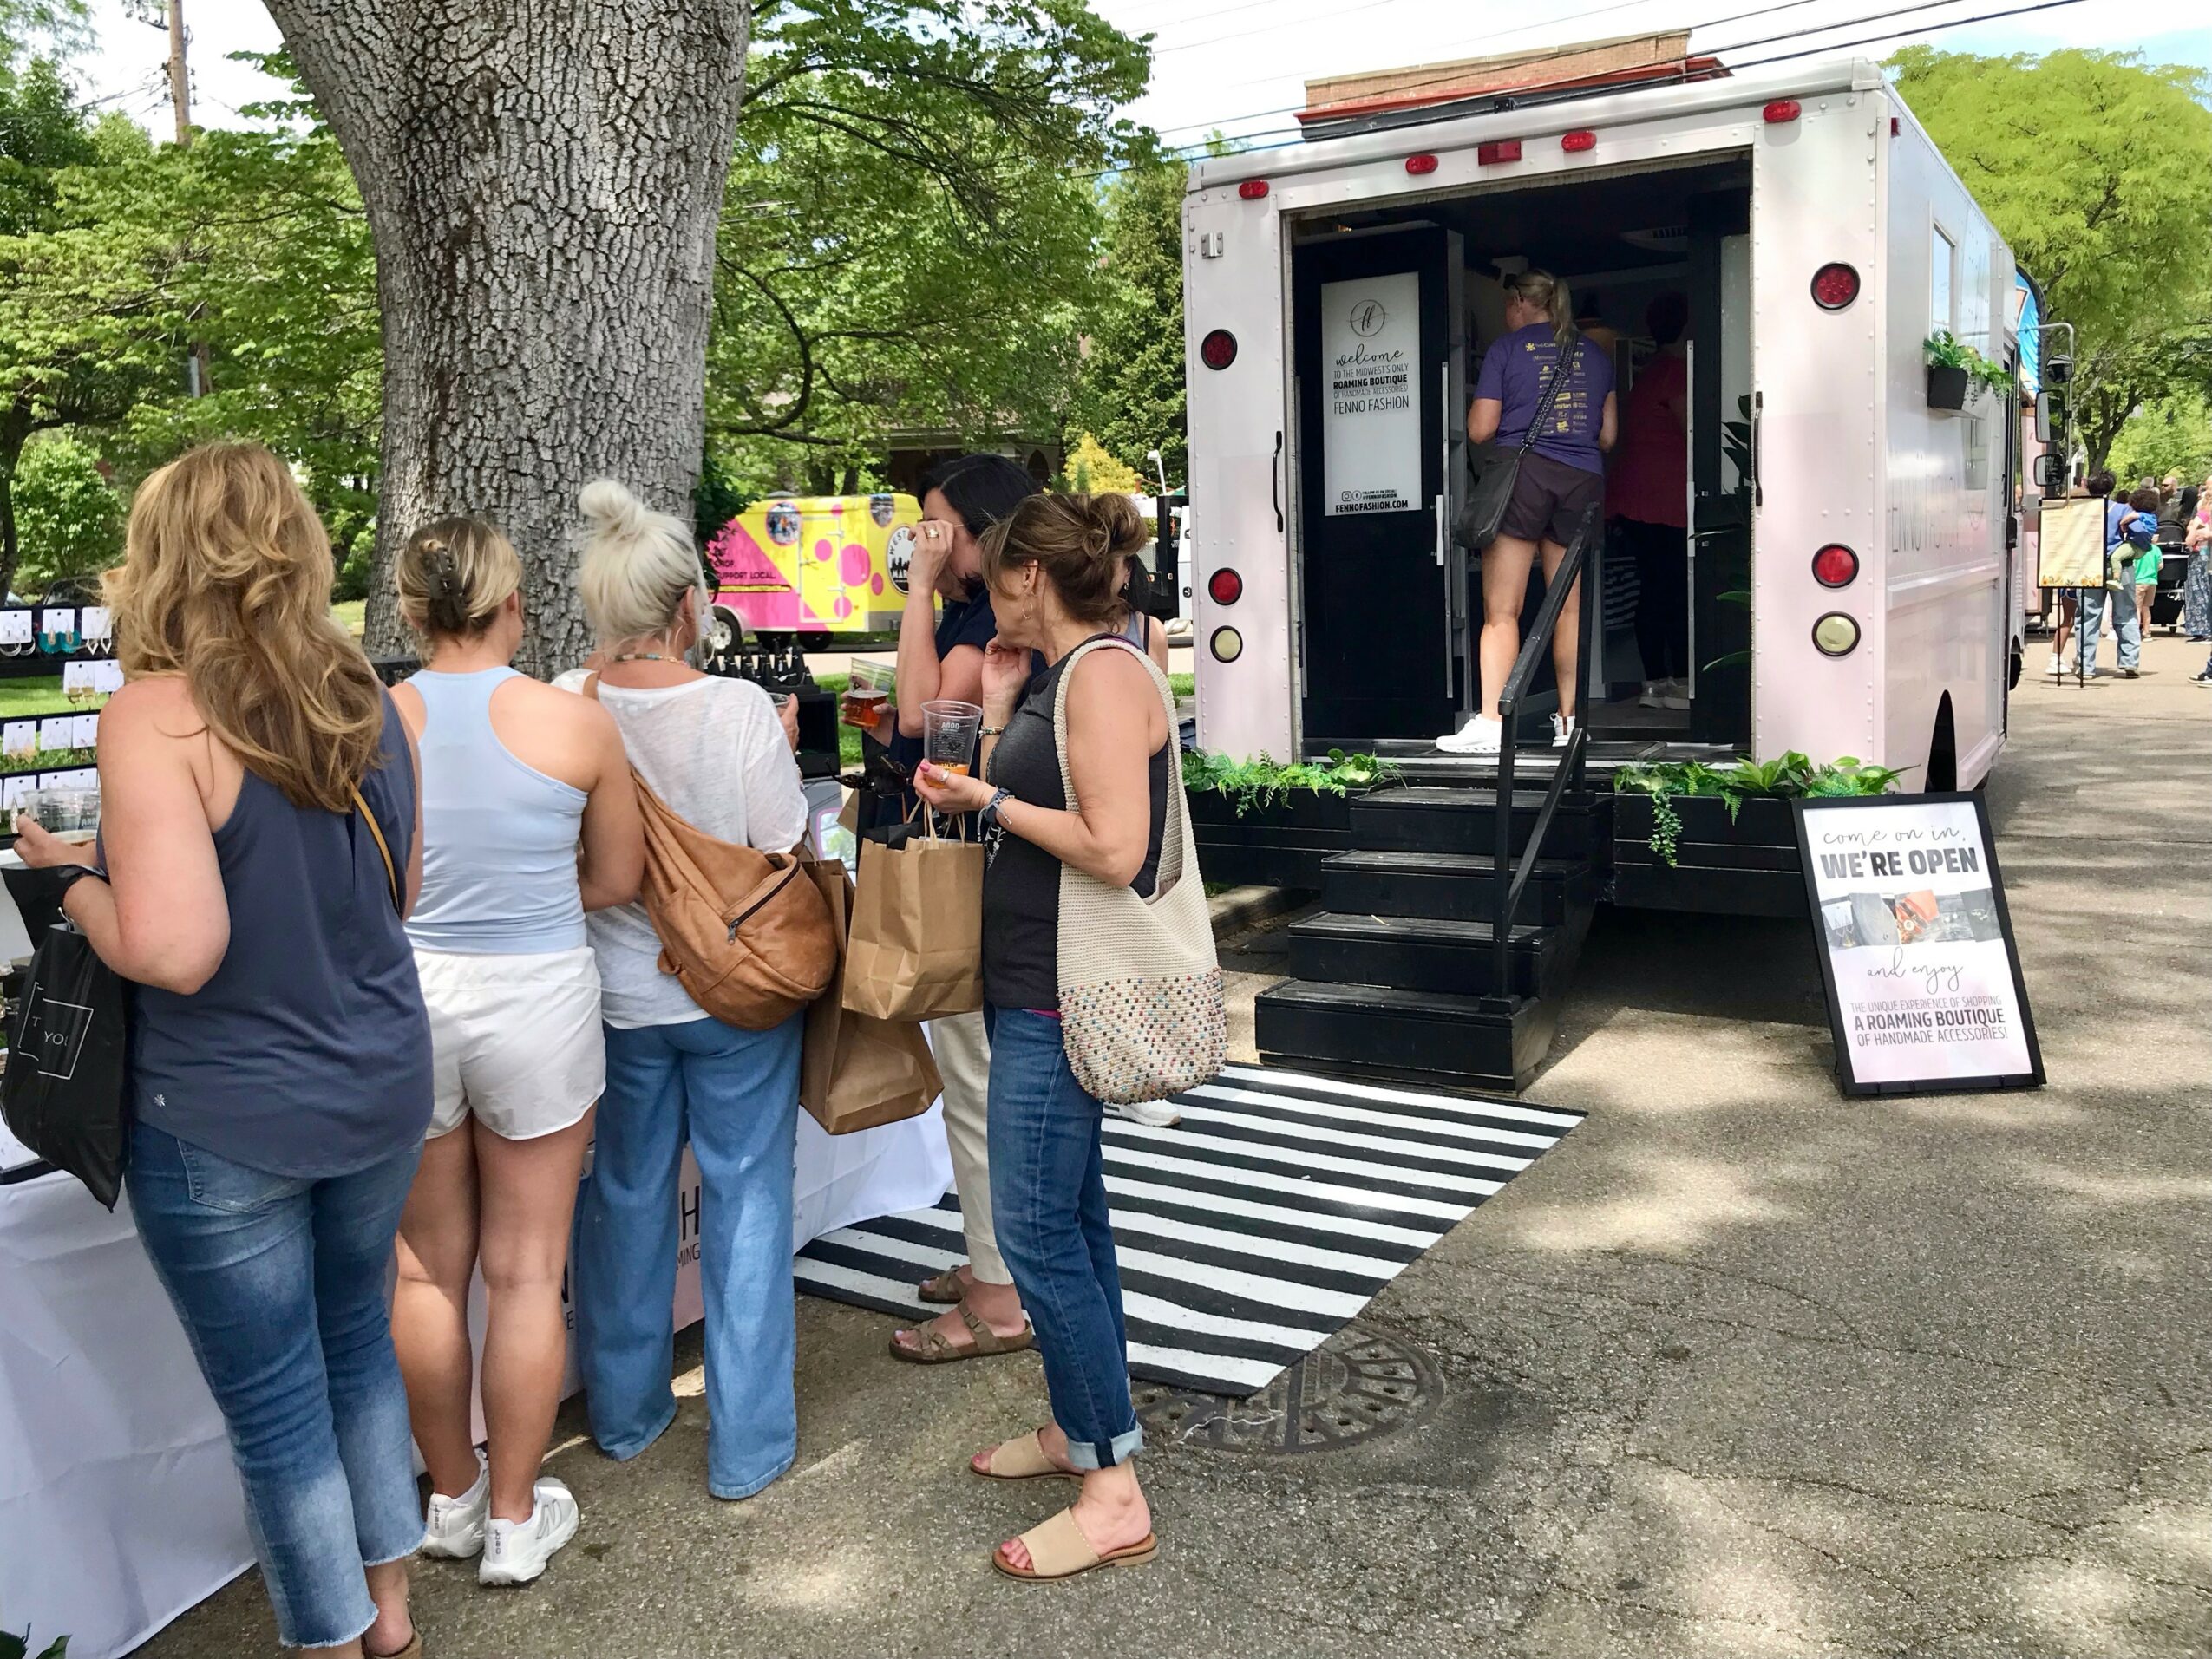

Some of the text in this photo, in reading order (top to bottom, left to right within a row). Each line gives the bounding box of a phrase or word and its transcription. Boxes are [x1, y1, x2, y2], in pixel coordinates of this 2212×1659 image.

[1336, 343, 1404, 366] welcome
[1334, 363, 1409, 379] TO THE MIDWEST'S ONLY
[1333, 374, 1408, 389] ROAMING BOUTIQUE
[1334, 395, 1410, 415] FENNO FASHION
[1335, 500, 1409, 513] FENNOFASHION.COM
[1823, 825, 1967, 846] come on in,
[1820, 847, 1980, 879] WE'RE OPEN
[1867, 946, 1964, 995] and enjoy
[1850, 995, 2002, 1014] THE UNIQUE EXPERIENCE OF SHOPPING
[1855, 1008, 2006, 1031] A ROAMING BOUTIQUE
[44, 1030, 69, 1047] YO
[1857, 1026, 2009, 1048] OF HANDMADE ACCESSORIES!
